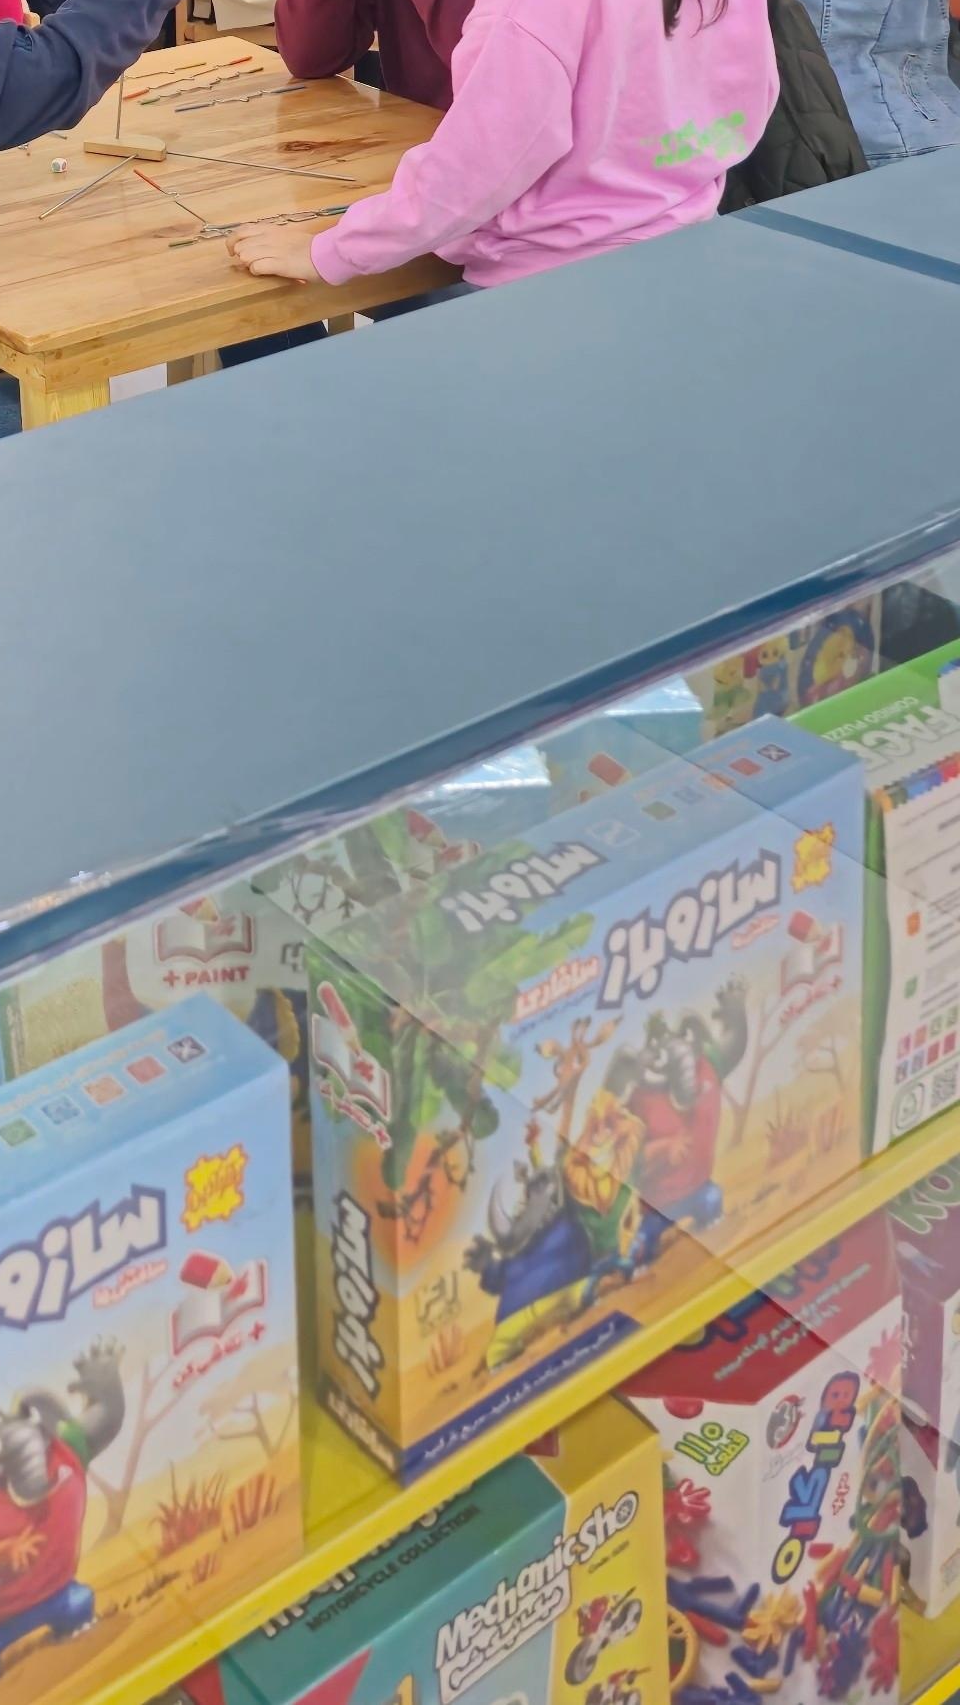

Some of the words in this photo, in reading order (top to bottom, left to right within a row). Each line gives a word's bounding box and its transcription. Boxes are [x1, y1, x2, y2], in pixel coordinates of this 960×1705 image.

[185, 965, 250, 987] PAINT
[306, 1564, 399, 1632] MOTORCYCLE
[398, 1503, 481, 1566] COLLECTION
[435, 1535, 578, 1670] Mechanic
